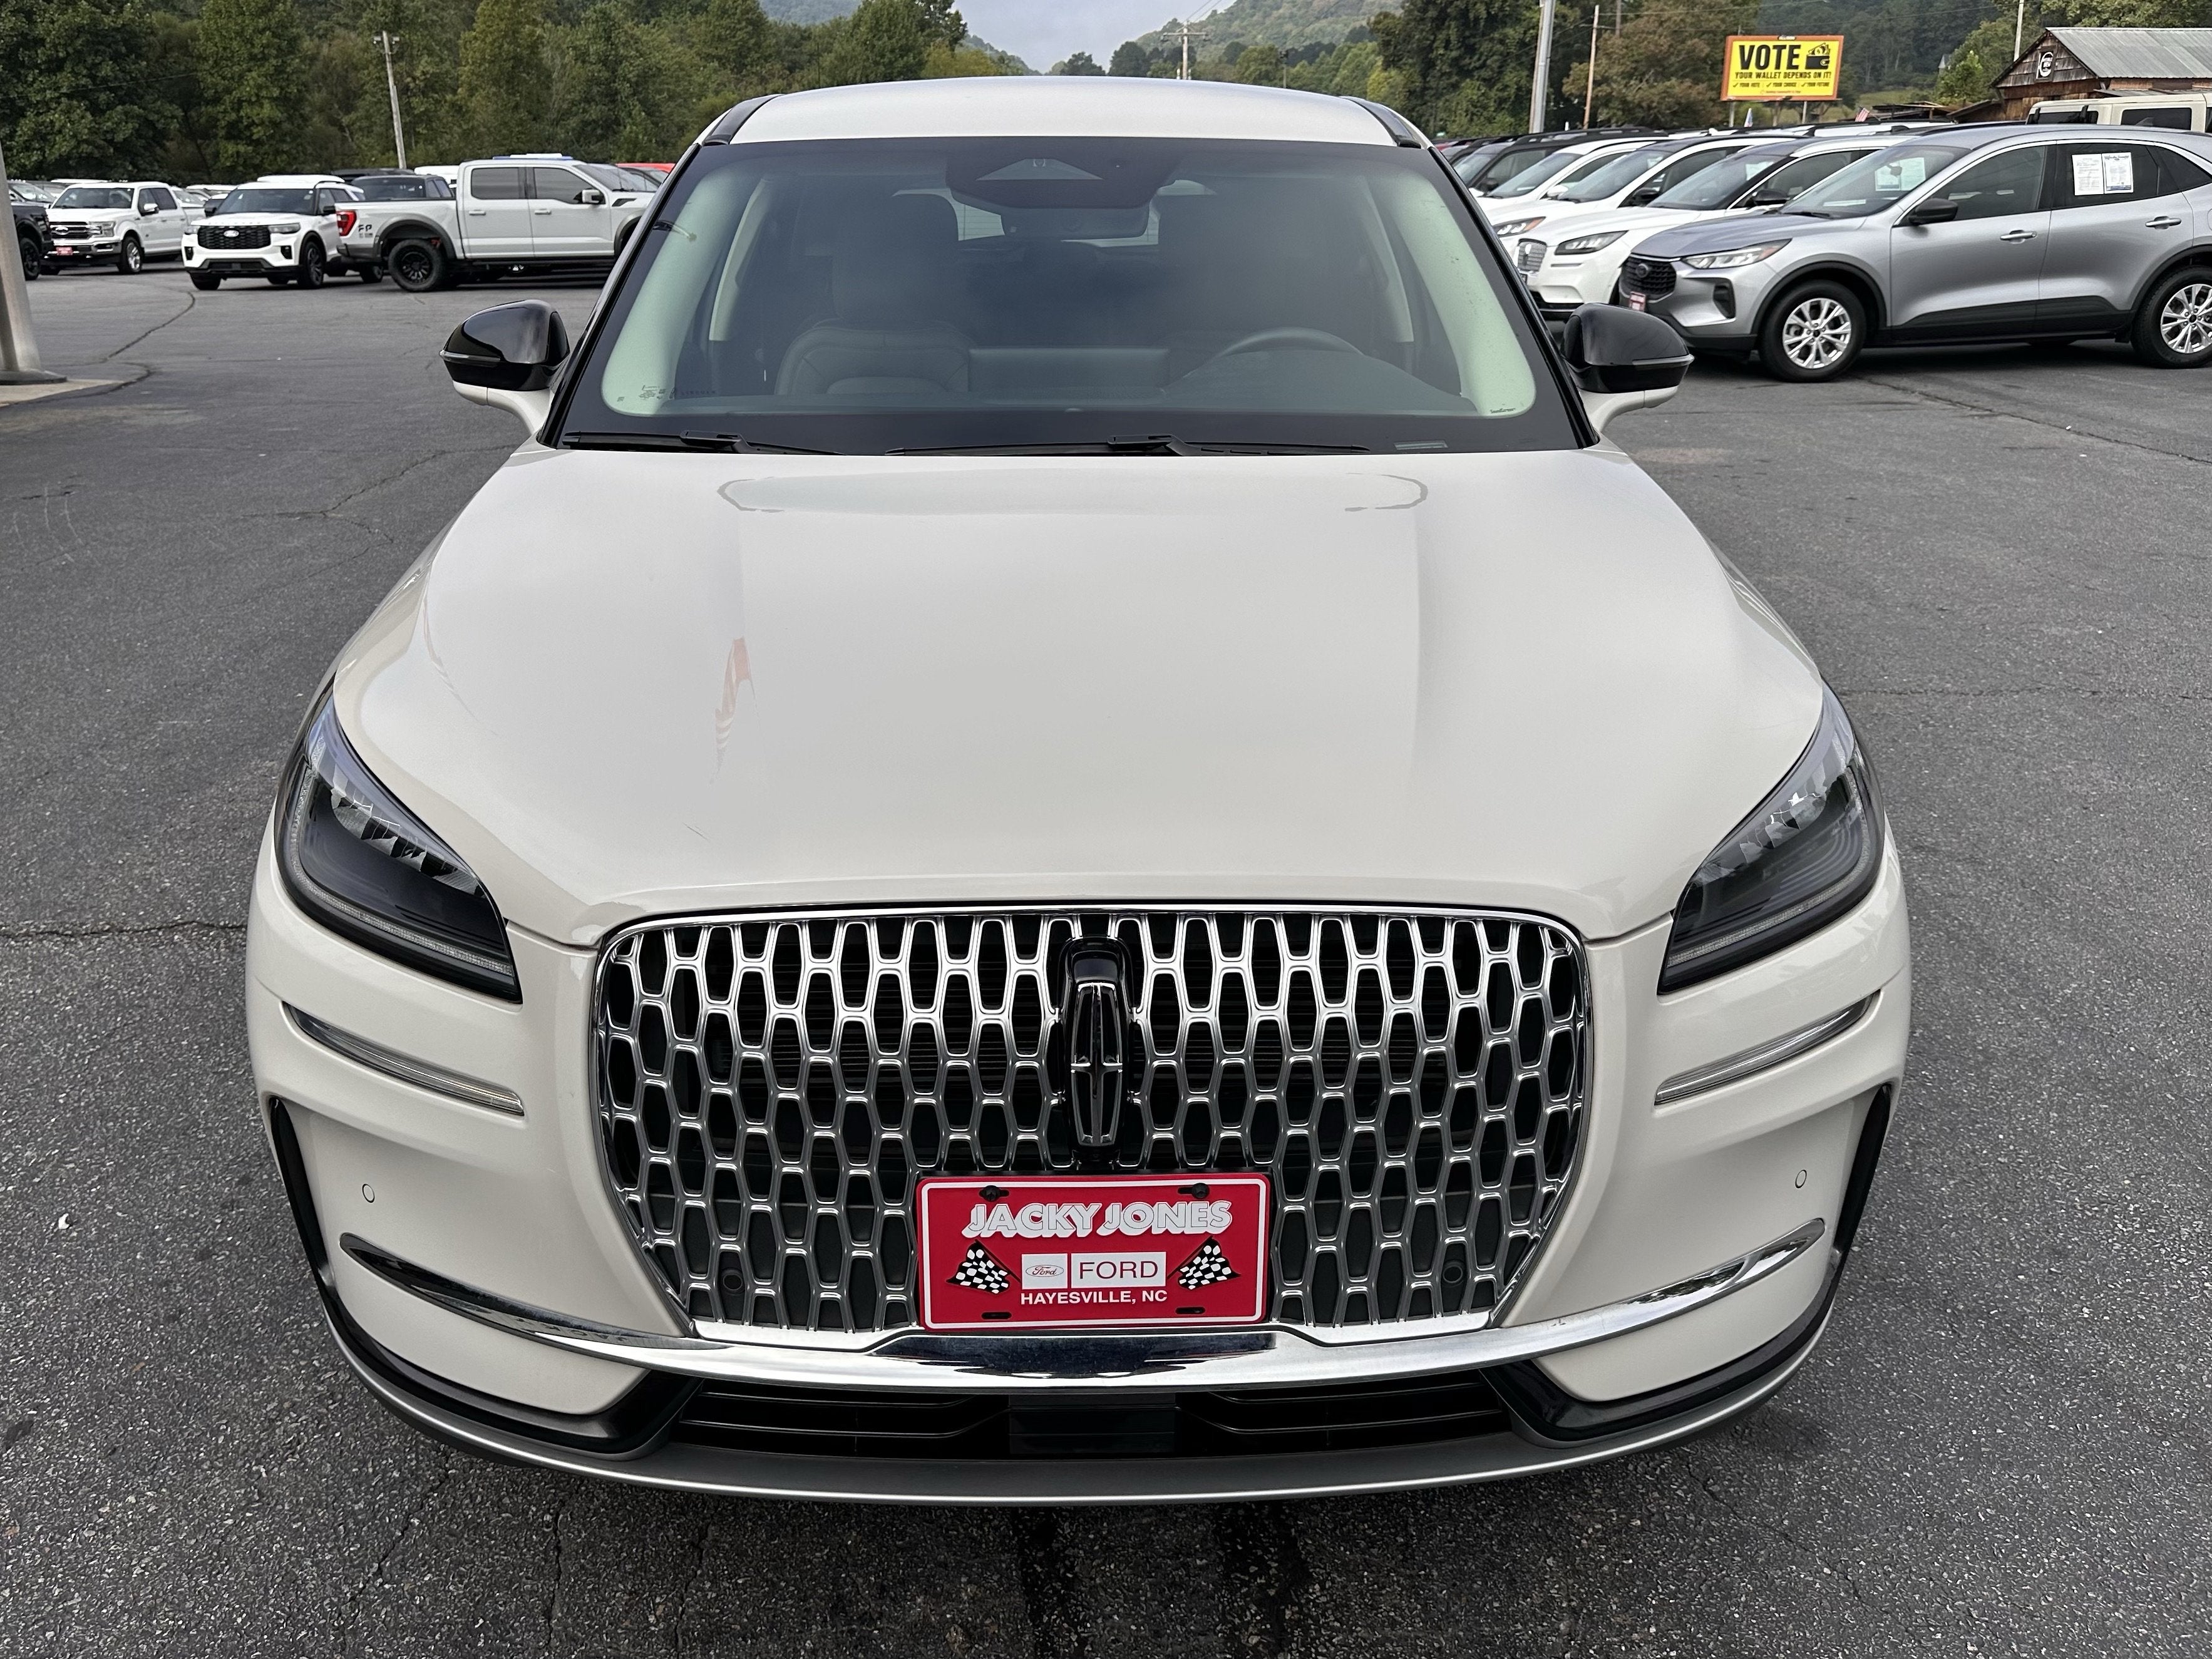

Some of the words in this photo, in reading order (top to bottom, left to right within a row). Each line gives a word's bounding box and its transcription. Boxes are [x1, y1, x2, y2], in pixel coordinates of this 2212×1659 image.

[1739, 44, 1801, 70] VOTE
[962, 1203, 1102, 1238] JACKY
[1096, 1200, 1232, 1236] JONES
[1032, 1265, 1057, 1276] Ford
[1079, 1261, 1158, 1279] FORD
[1021, 1290, 1136, 1305] HAYESVILLE,
[1142, 1290, 1168, 1302] NC
